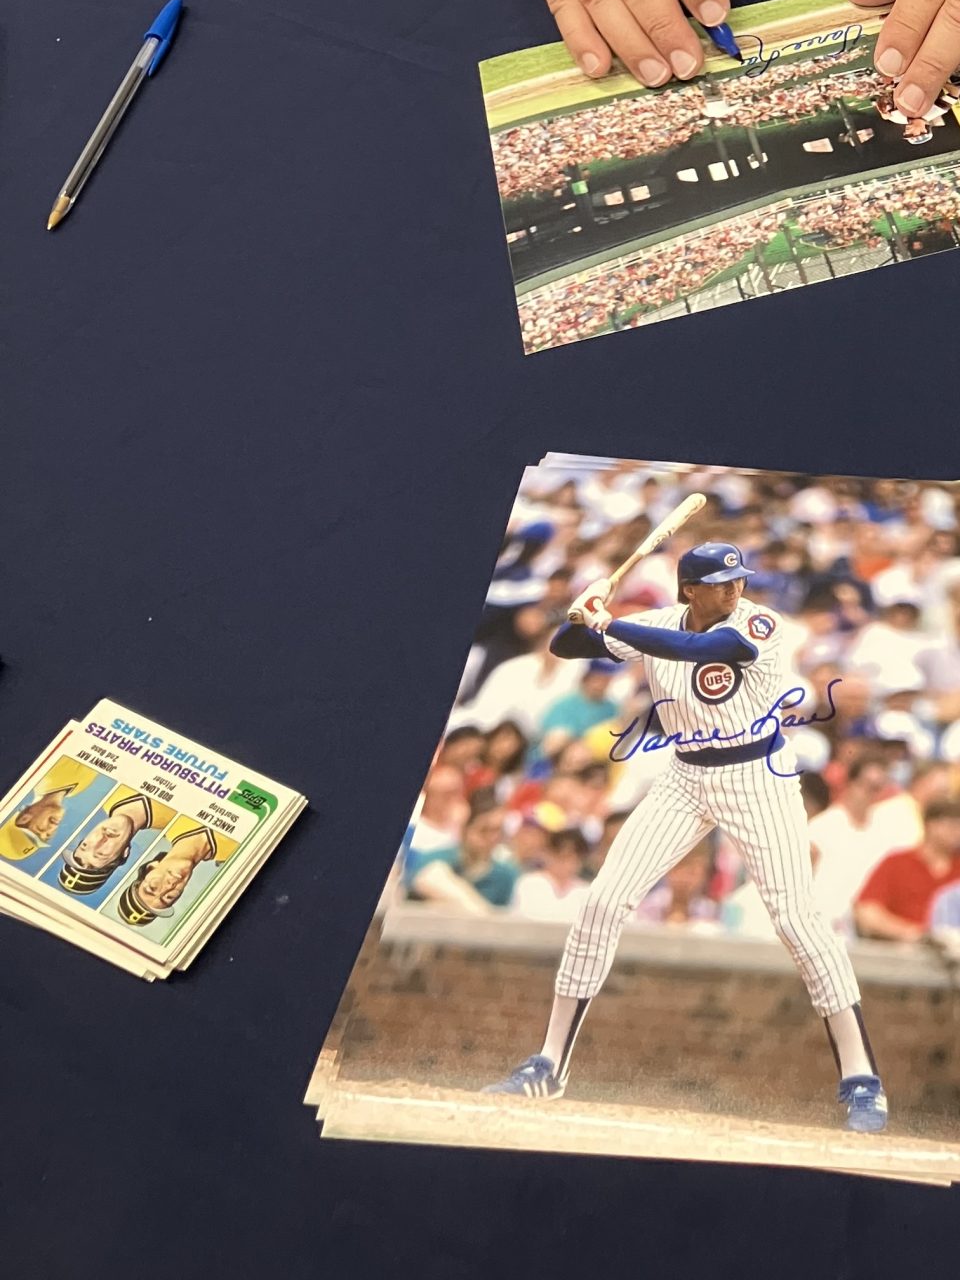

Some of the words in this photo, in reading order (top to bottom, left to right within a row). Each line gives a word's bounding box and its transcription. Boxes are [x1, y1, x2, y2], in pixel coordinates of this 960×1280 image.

[111, 718, 164, 749] STARS
[609, 698, 745, 762] Vance
[750, 678, 842, 778] Law
[85, 722, 143, 755] PIRATES
[77, 749, 91, 760] RAY
[91, 744, 106, 754] Base
[106, 752, 119, 762] 2nd
[89, 755, 117, 773] JOHNNY
[163, 743, 229, 781] FUTURE
[141, 749, 231, 800] PITTSBURGH
[140, 780, 160, 795] LONG
[153, 775, 177, 791] Pitcher
[158, 790, 174, 802] BOB
[196, 809, 215, 823] LAW
[208, 802, 240, 823] Shortstop
[212, 819, 236, 834] VANCE
